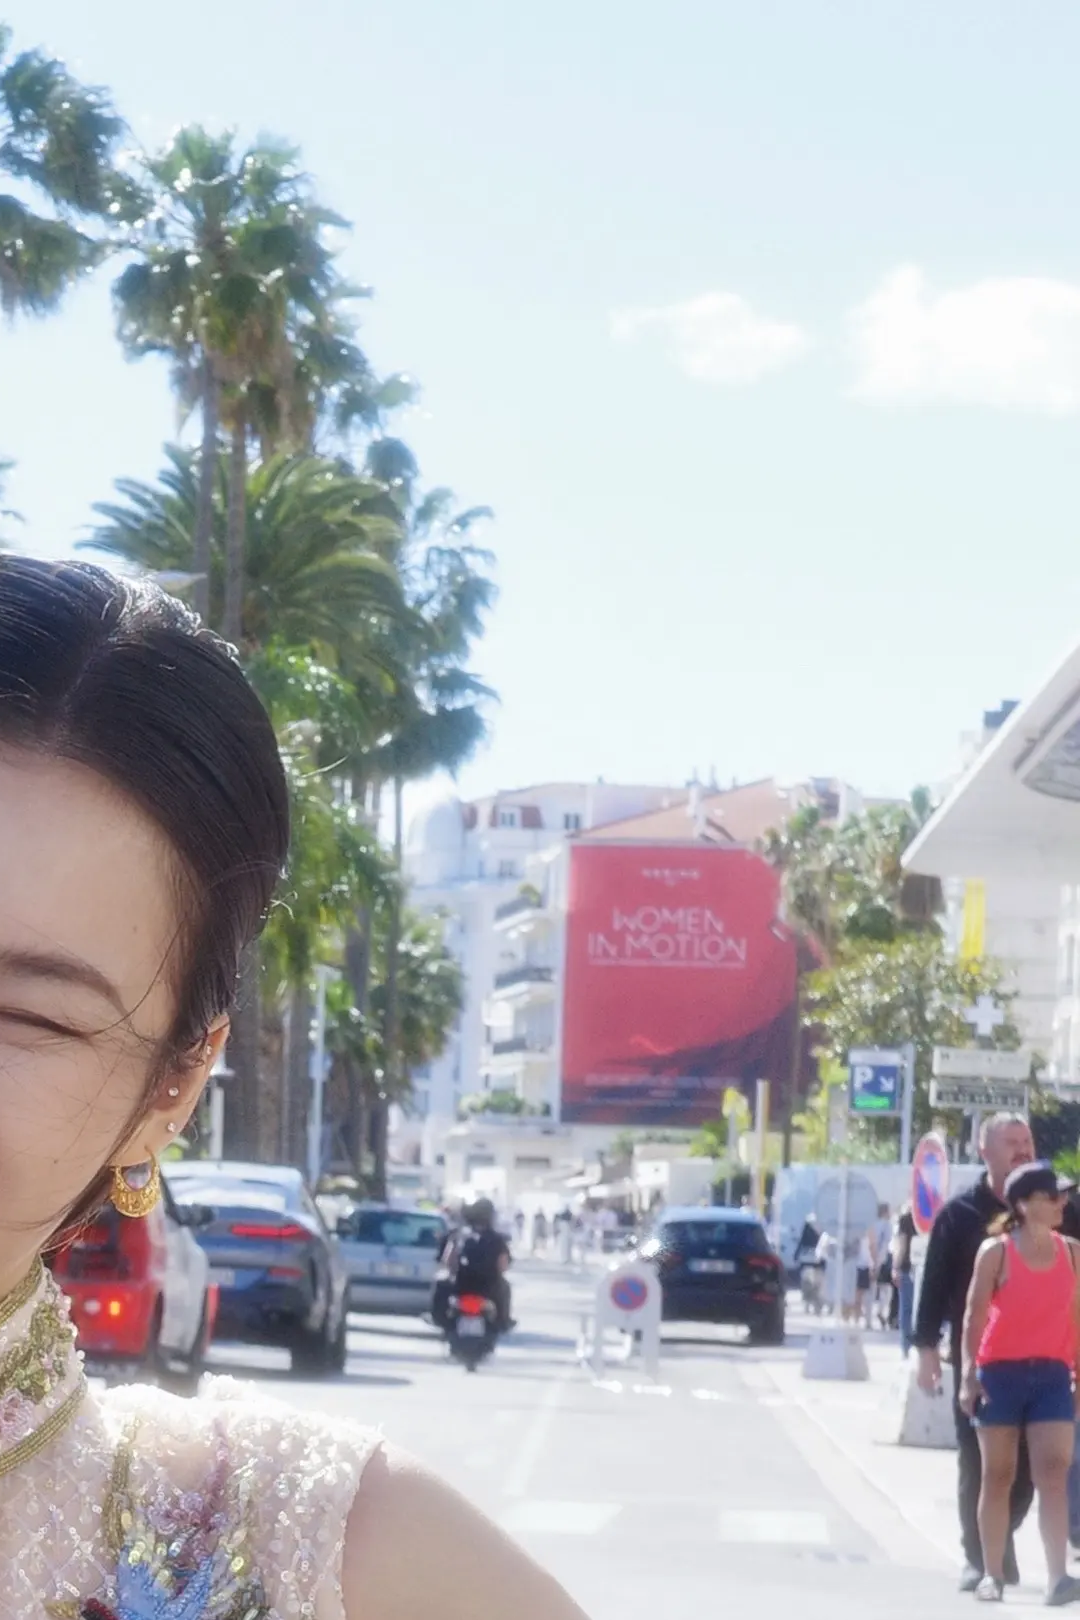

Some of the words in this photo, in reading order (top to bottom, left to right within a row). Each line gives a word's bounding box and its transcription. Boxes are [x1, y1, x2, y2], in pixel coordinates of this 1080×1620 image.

[612, 906, 724, 934] WOMEN
[588, 932, 618, 957] IN
[625, 932, 748, 961] MOTION
[854, 1066, 874, 1088] P
